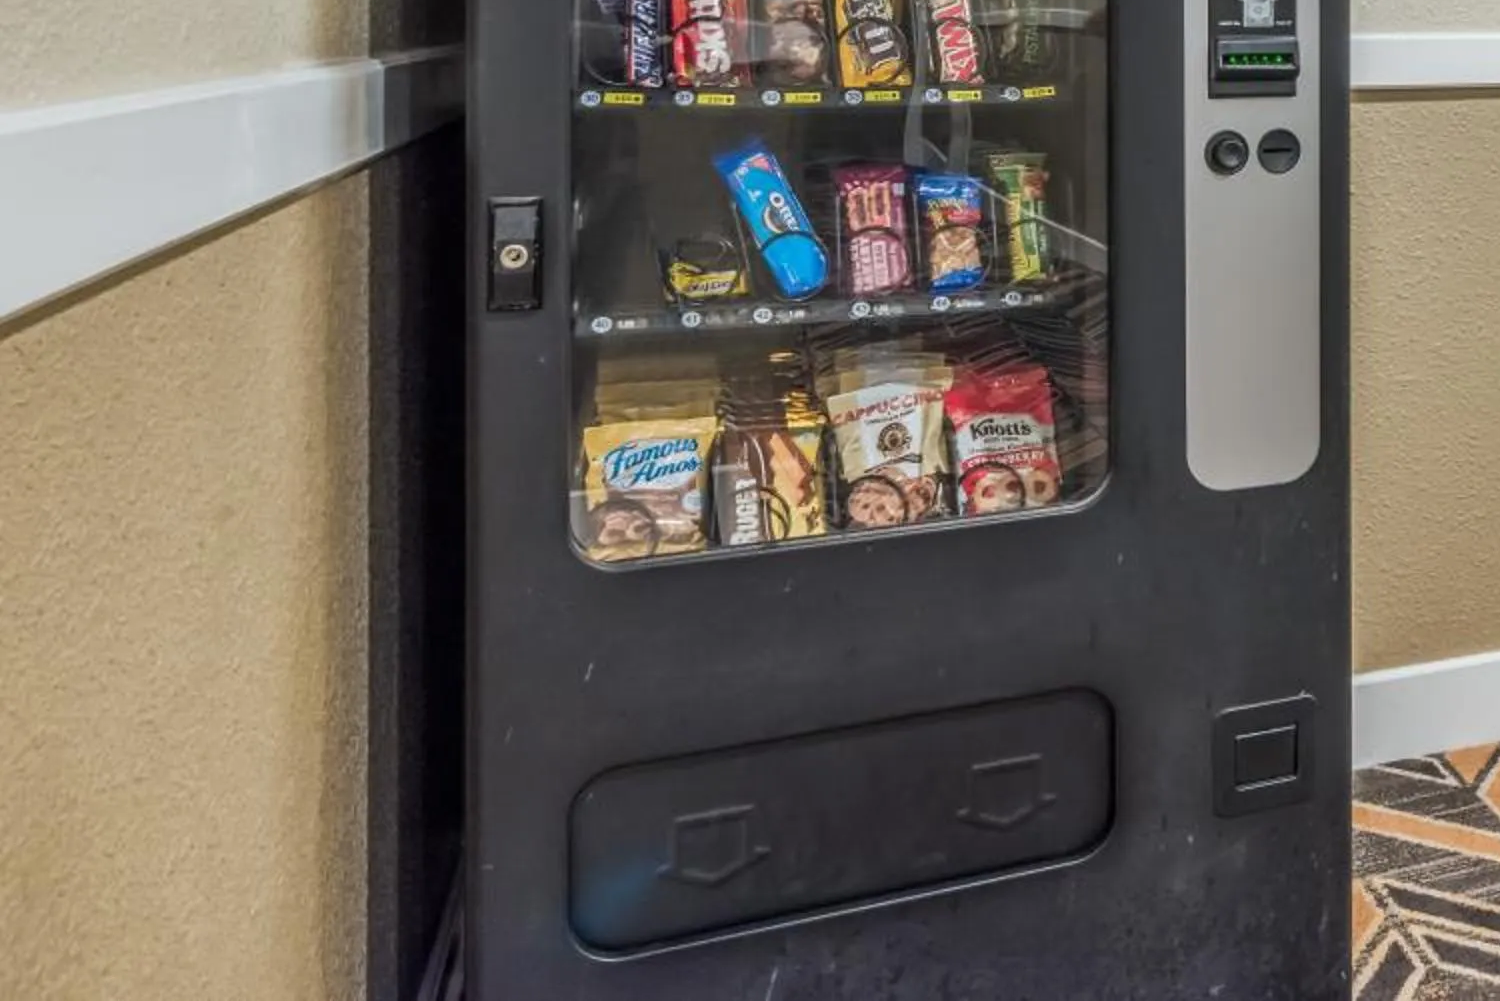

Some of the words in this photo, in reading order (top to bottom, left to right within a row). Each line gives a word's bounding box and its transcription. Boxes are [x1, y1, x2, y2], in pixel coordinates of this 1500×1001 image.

[769, 192, 800, 232] ORE
[969, 418, 1032, 440] Knott's
[604, 438, 699, 481] Famous
[624, 457, 704, 487] Amos
